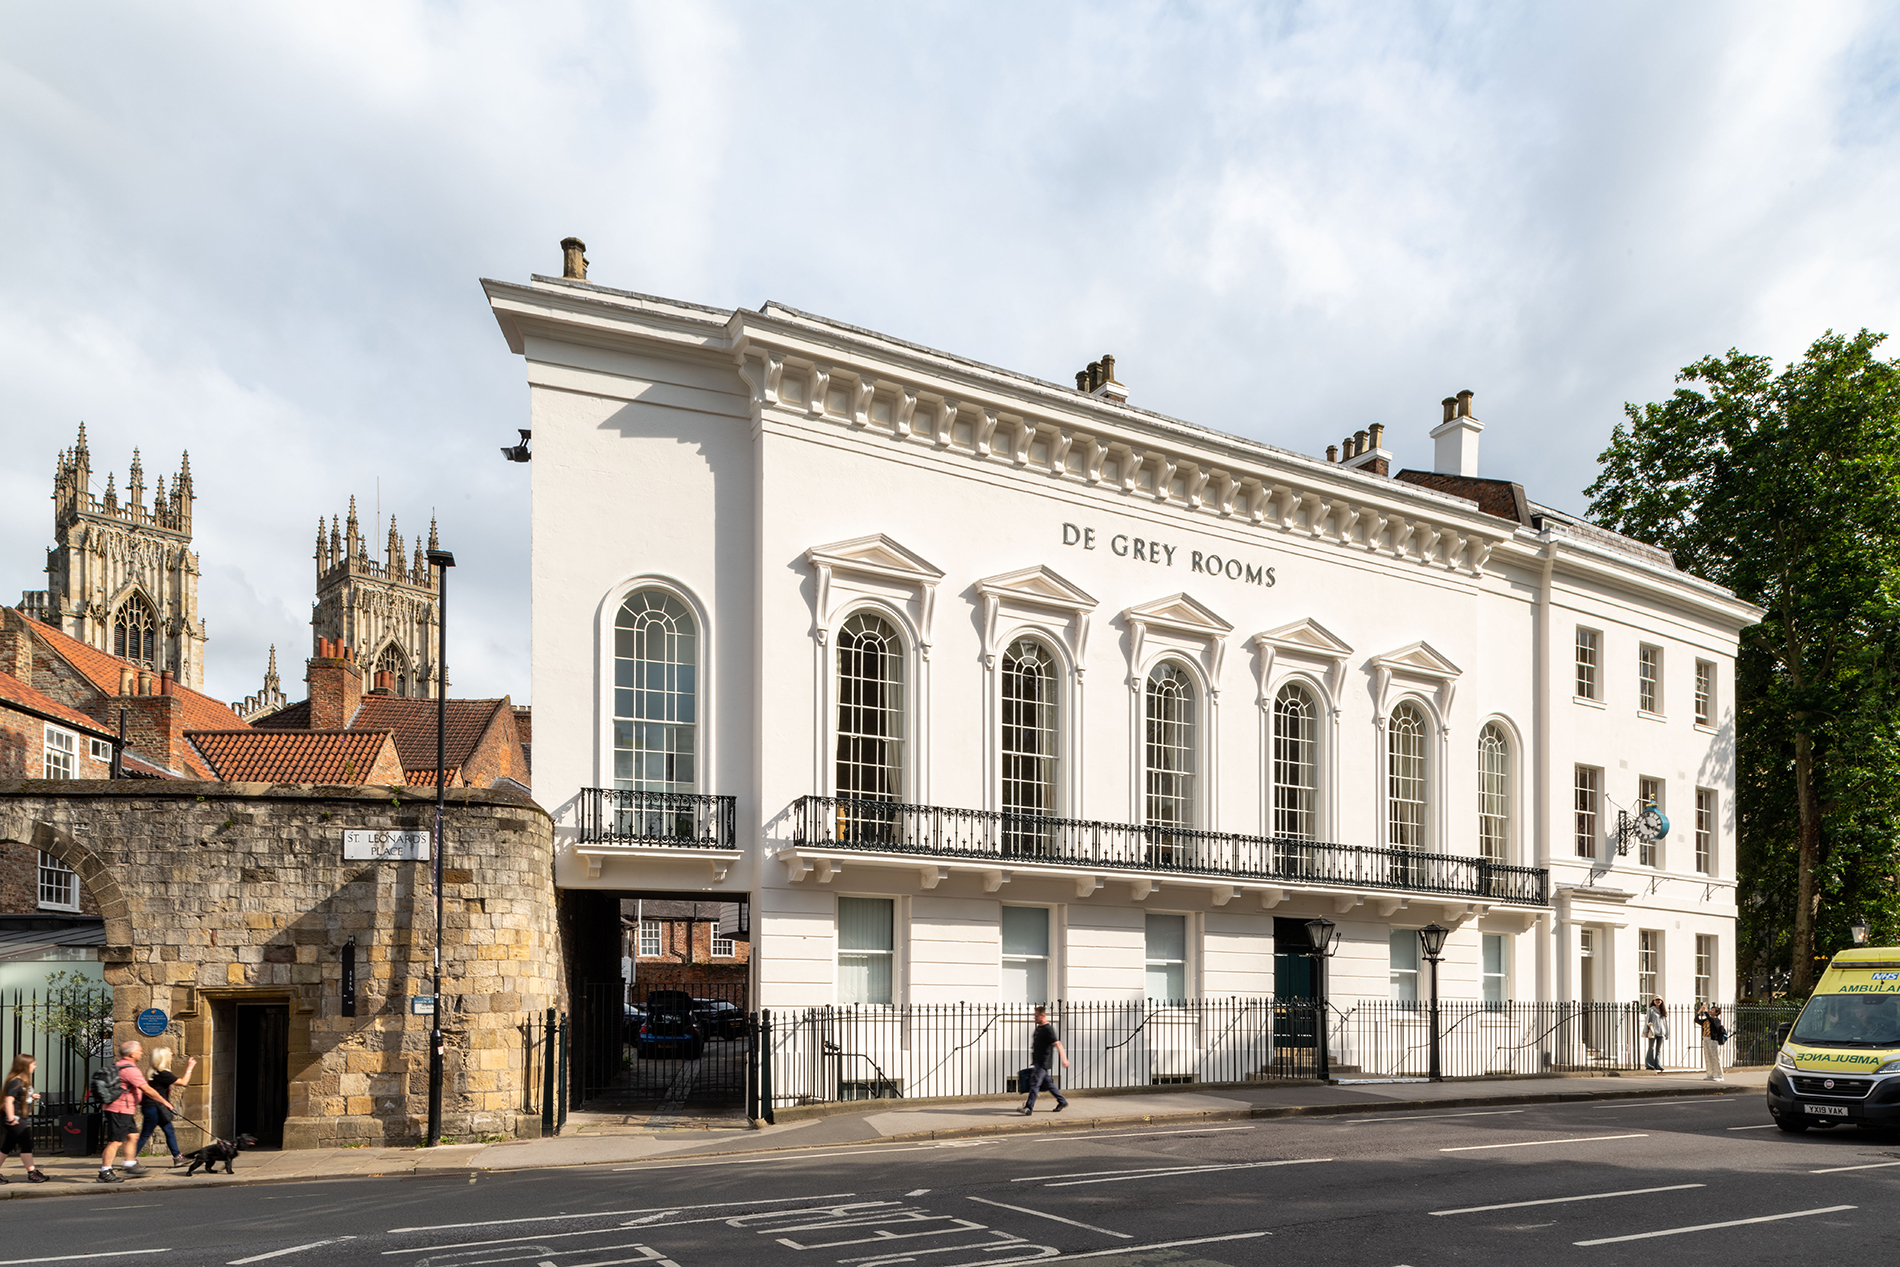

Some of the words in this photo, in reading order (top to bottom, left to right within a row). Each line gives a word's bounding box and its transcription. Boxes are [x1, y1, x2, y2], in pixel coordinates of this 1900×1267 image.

[1062, 522, 1096, 550] DE
[1111, 534, 1177, 567] GREY
[1191, 550, 1276, 588] ROOMS
[371, 847, 403, 856] PLACE
[1838, 985, 1900, 993] AMBULA
[1809, 1106, 1827, 1114] YX19
[1827, 1107, 1844, 1115] VAK
